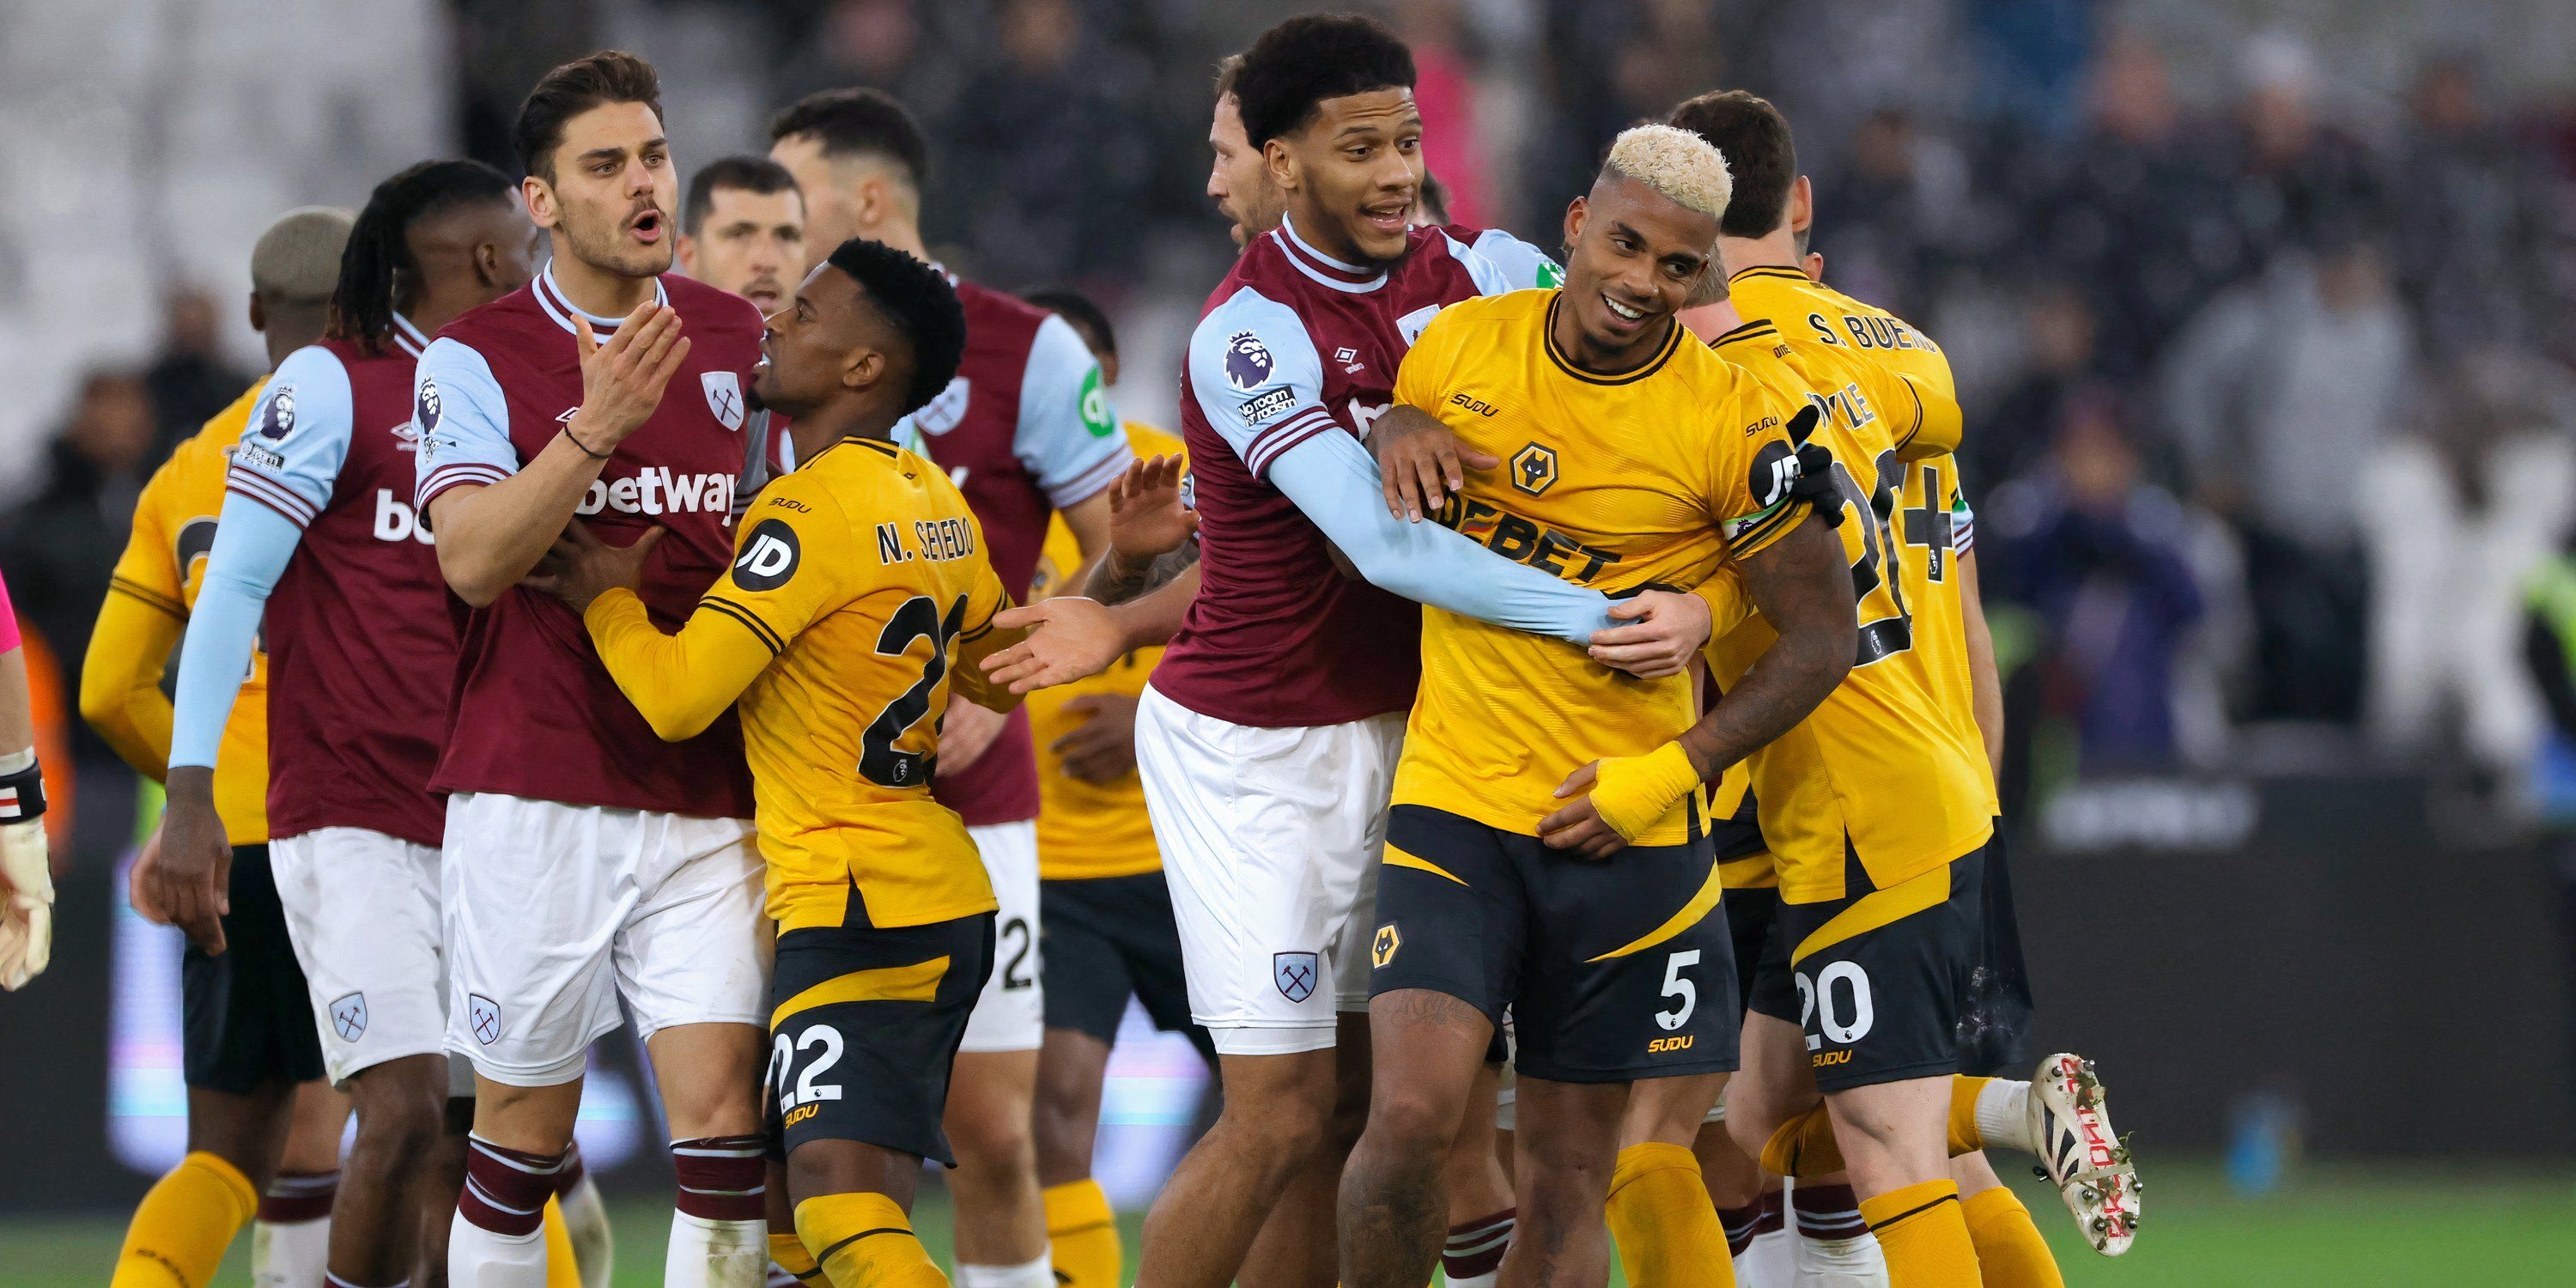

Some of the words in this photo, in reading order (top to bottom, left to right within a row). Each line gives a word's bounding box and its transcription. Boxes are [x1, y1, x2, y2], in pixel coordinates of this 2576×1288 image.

[1807, 313, 1846, 347] S.
[1237, 404, 1255, 417] No
[1253, 390, 1288, 411] room
[1256, 398, 1299, 421] racsm
[1450, 393, 1500, 418] SUDU
[1745, 416, 1779, 438] SUDU
[769, 496, 812, 514] SUDU
[735, 533, 793, 577] JD
[876, 521, 914, 566] N.
[1654, 949, 1701, 1031] 5
[1794, 959, 1874, 1053] 20
[1647, 1034, 1694, 1054] SUDU
[774, 1024, 844, 1116] 22
[1812, 1048, 1853, 1068] SUDU
[785, 1103, 819, 1130] SUDU
